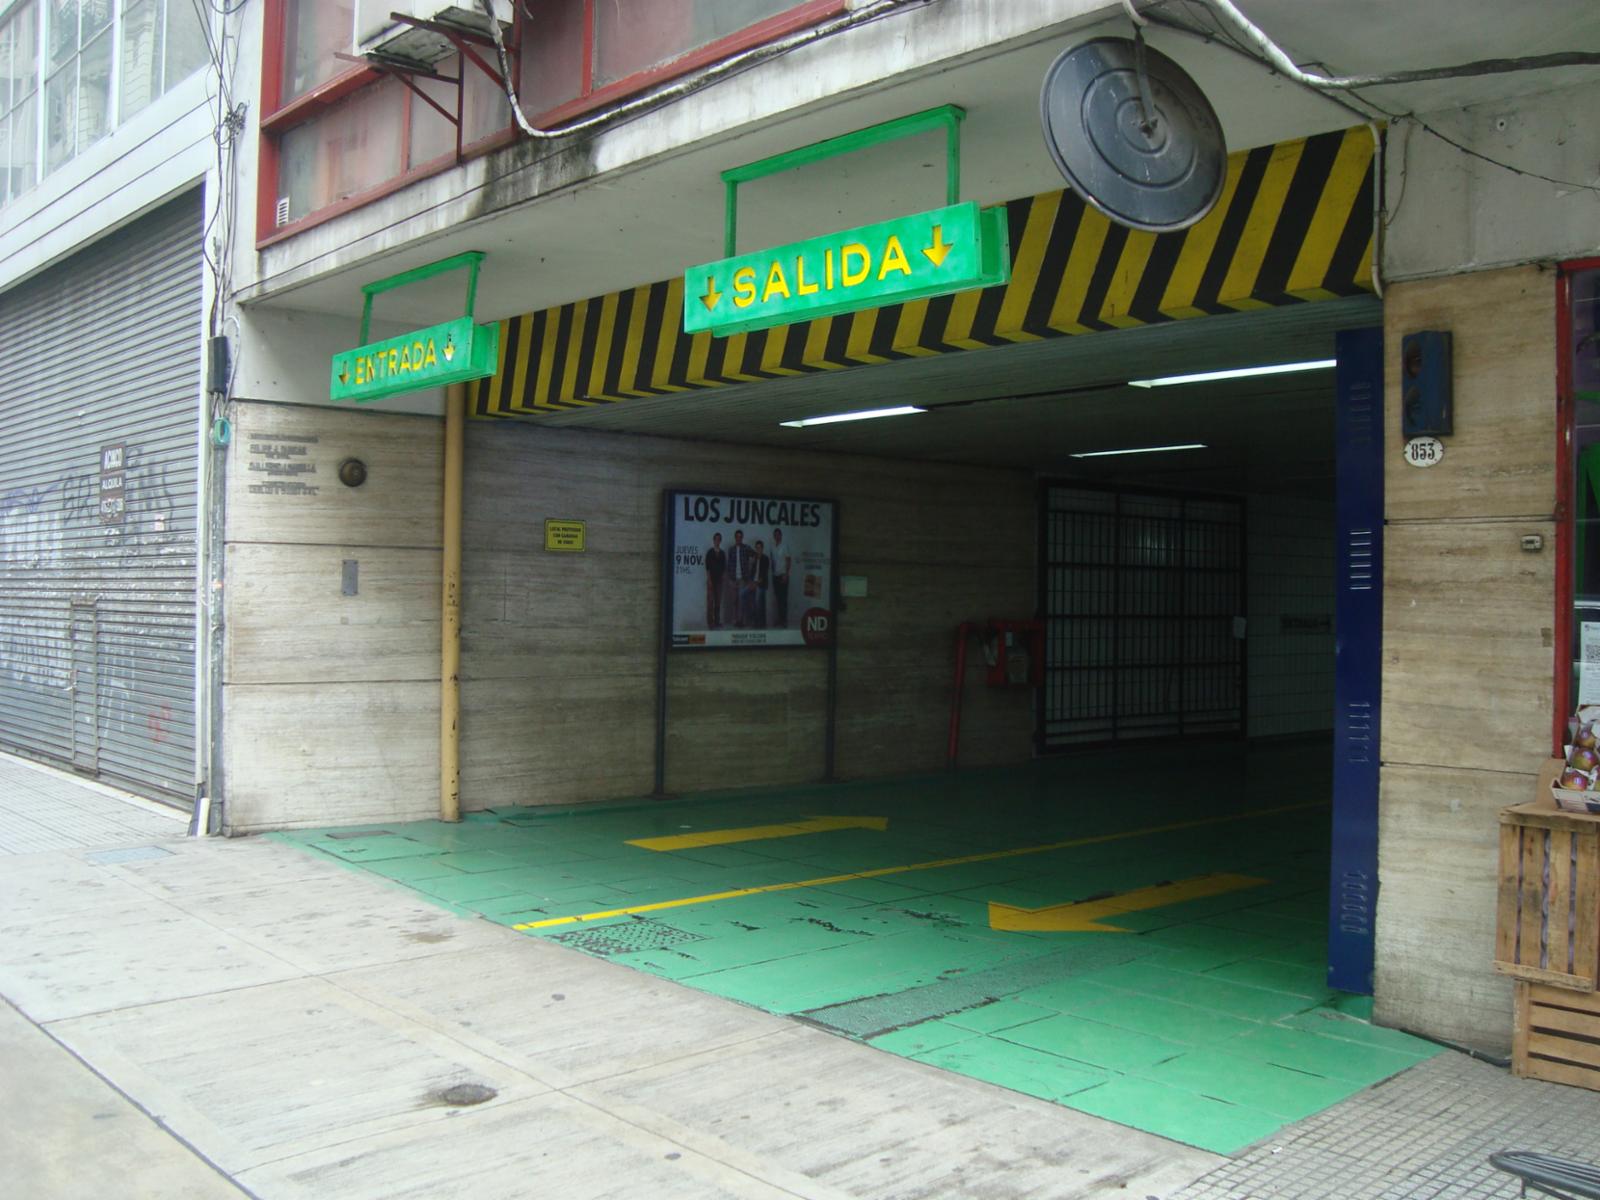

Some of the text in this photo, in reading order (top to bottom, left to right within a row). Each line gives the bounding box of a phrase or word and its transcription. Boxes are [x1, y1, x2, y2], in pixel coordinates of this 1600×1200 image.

[733, 235, 912, 307] SALIDA
[355, 338, 437, 385] ENTRADA
[1411, 442, 1435, 460] 853
[684, 497, 820, 527] LOS JUNCALES
[676, 555, 682, 565] 9
[807, 616, 828, 631] ND
